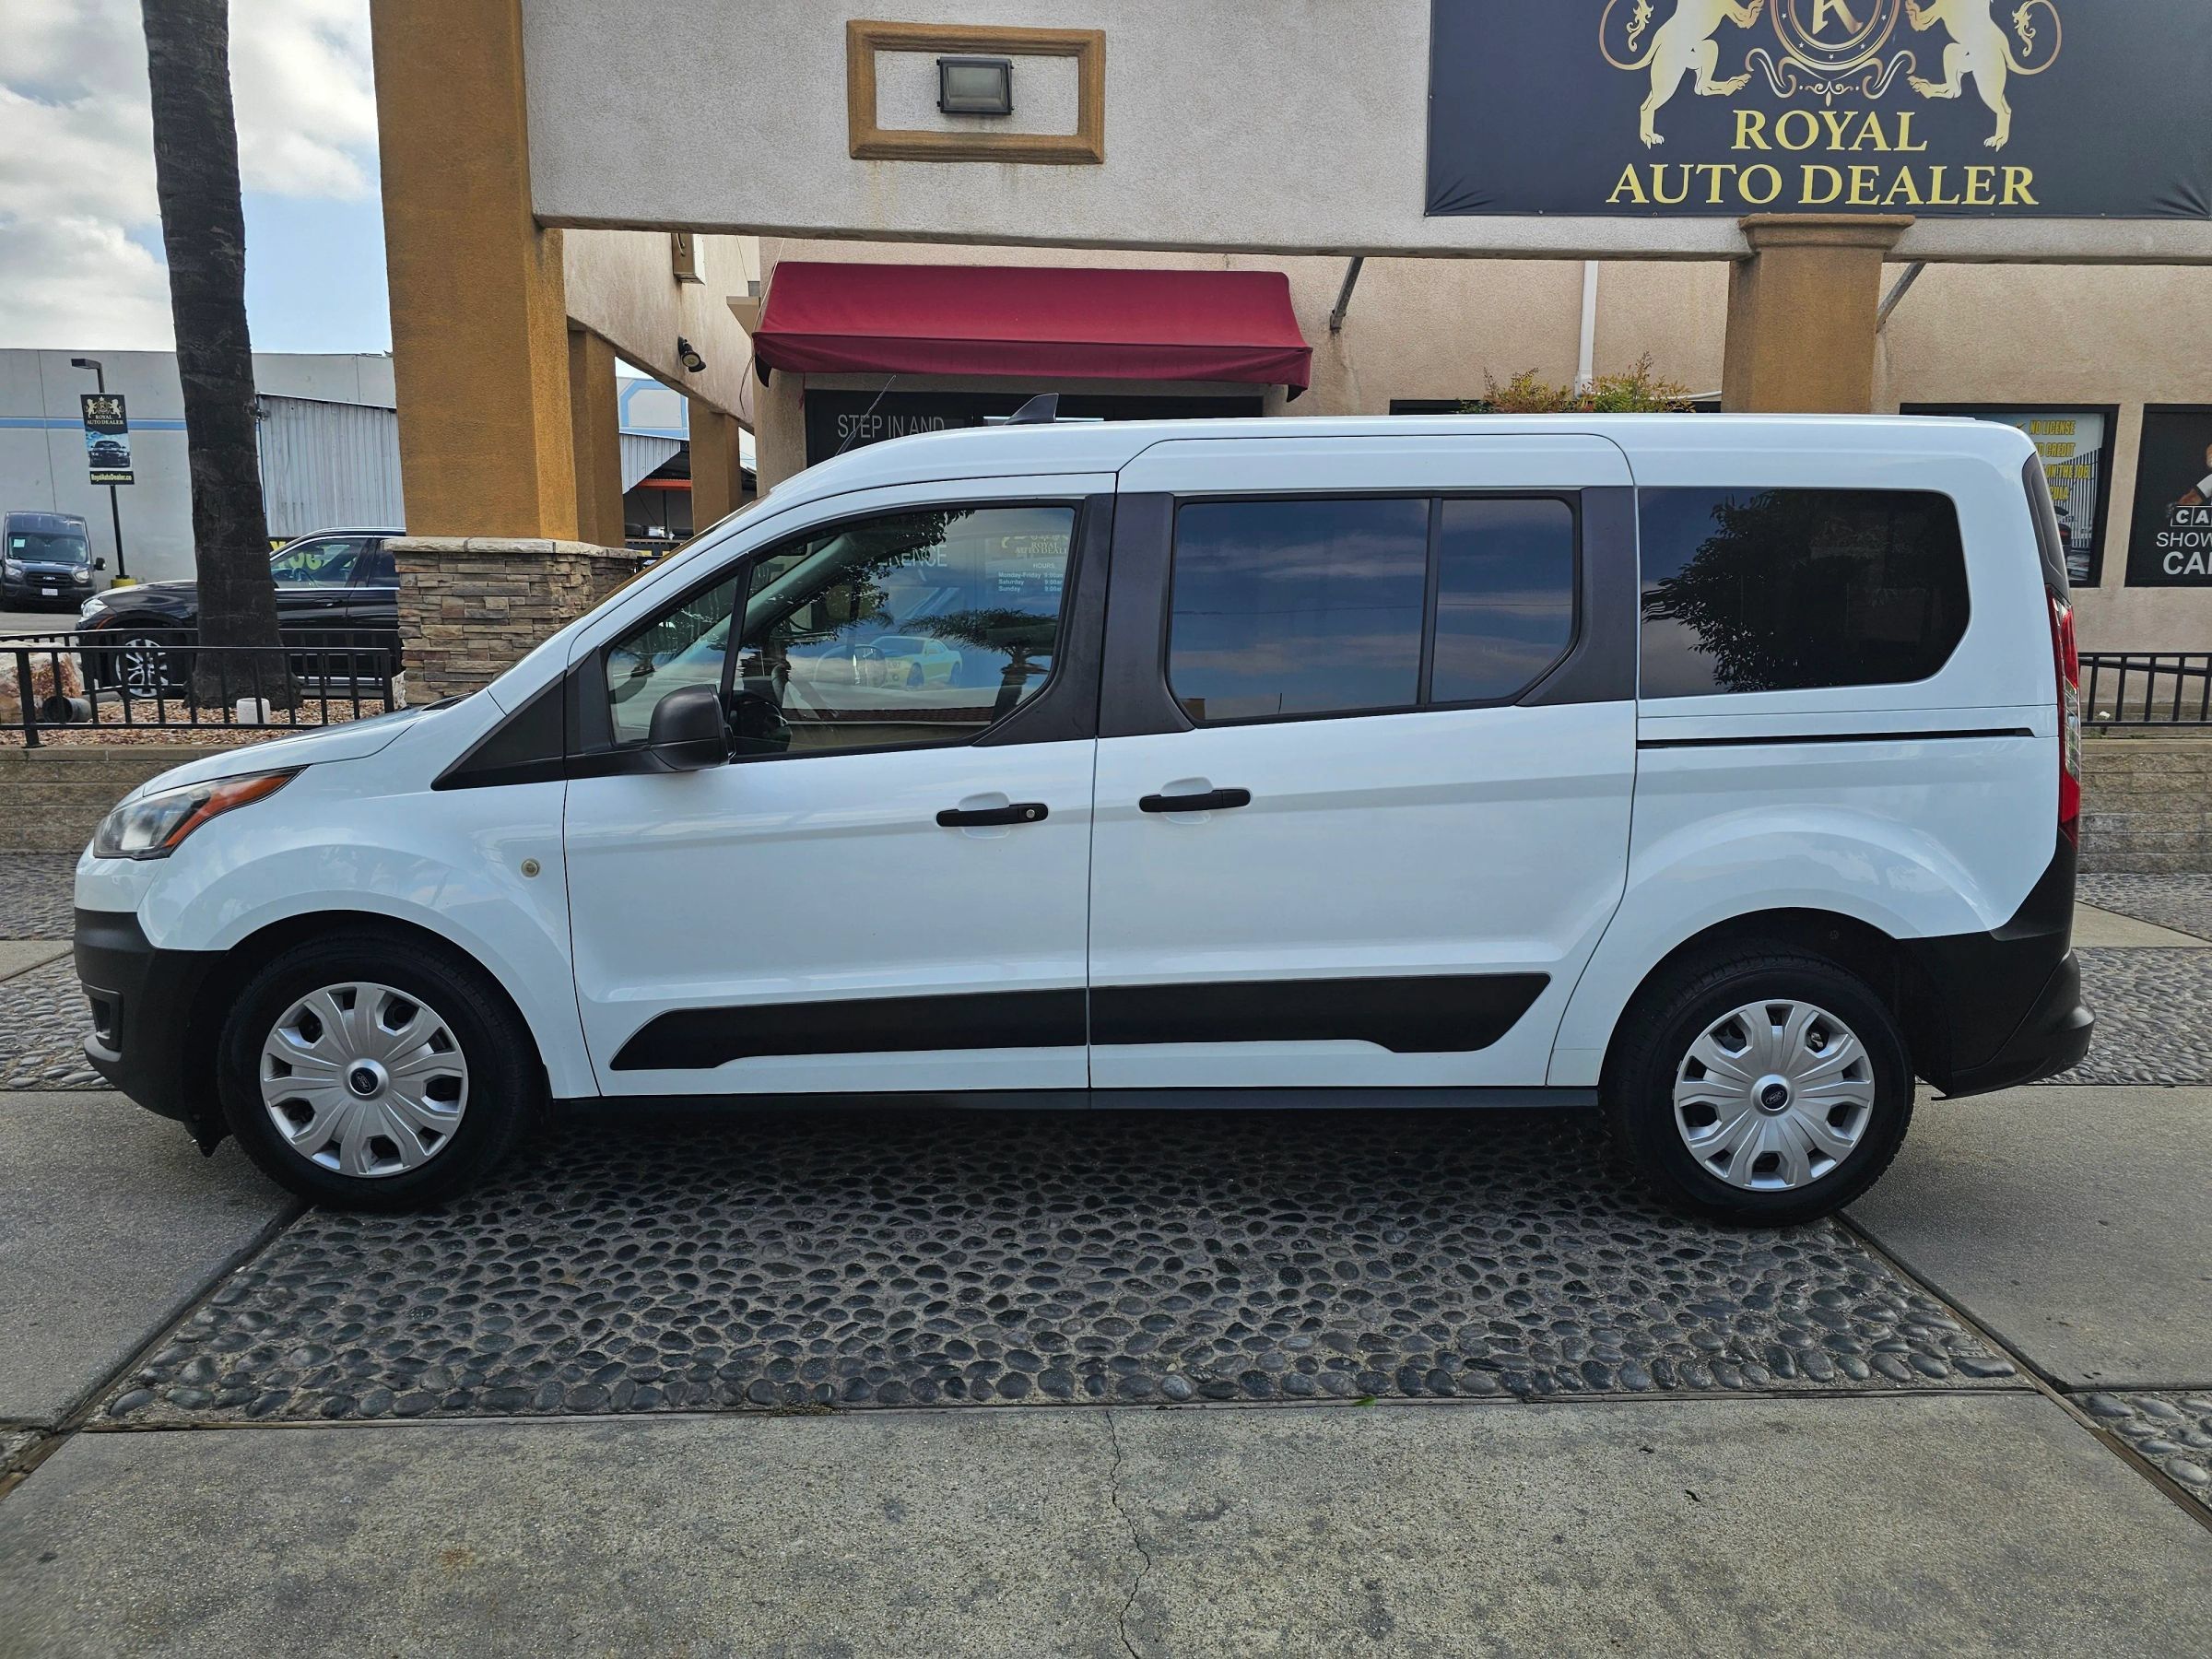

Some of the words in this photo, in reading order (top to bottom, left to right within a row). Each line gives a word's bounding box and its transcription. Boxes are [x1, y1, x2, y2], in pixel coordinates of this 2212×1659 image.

[1731, 110, 1928, 151] ROYAL
[1606, 163, 1783, 204] AUTO
[1798, 164, 2040, 206] DEALER
[838, 414, 883, 438] STEP
[888, 415, 904, 438] IN
[909, 416, 945, 435] AND
[2042, 420, 2076, 435] LICENSE
[2046, 442, 2076, 457] CREDIT
[2076, 465, 2089, 478] JOB
[2157, 533, 2212, 547] SHOW
[2163, 551, 2212, 574] CA
